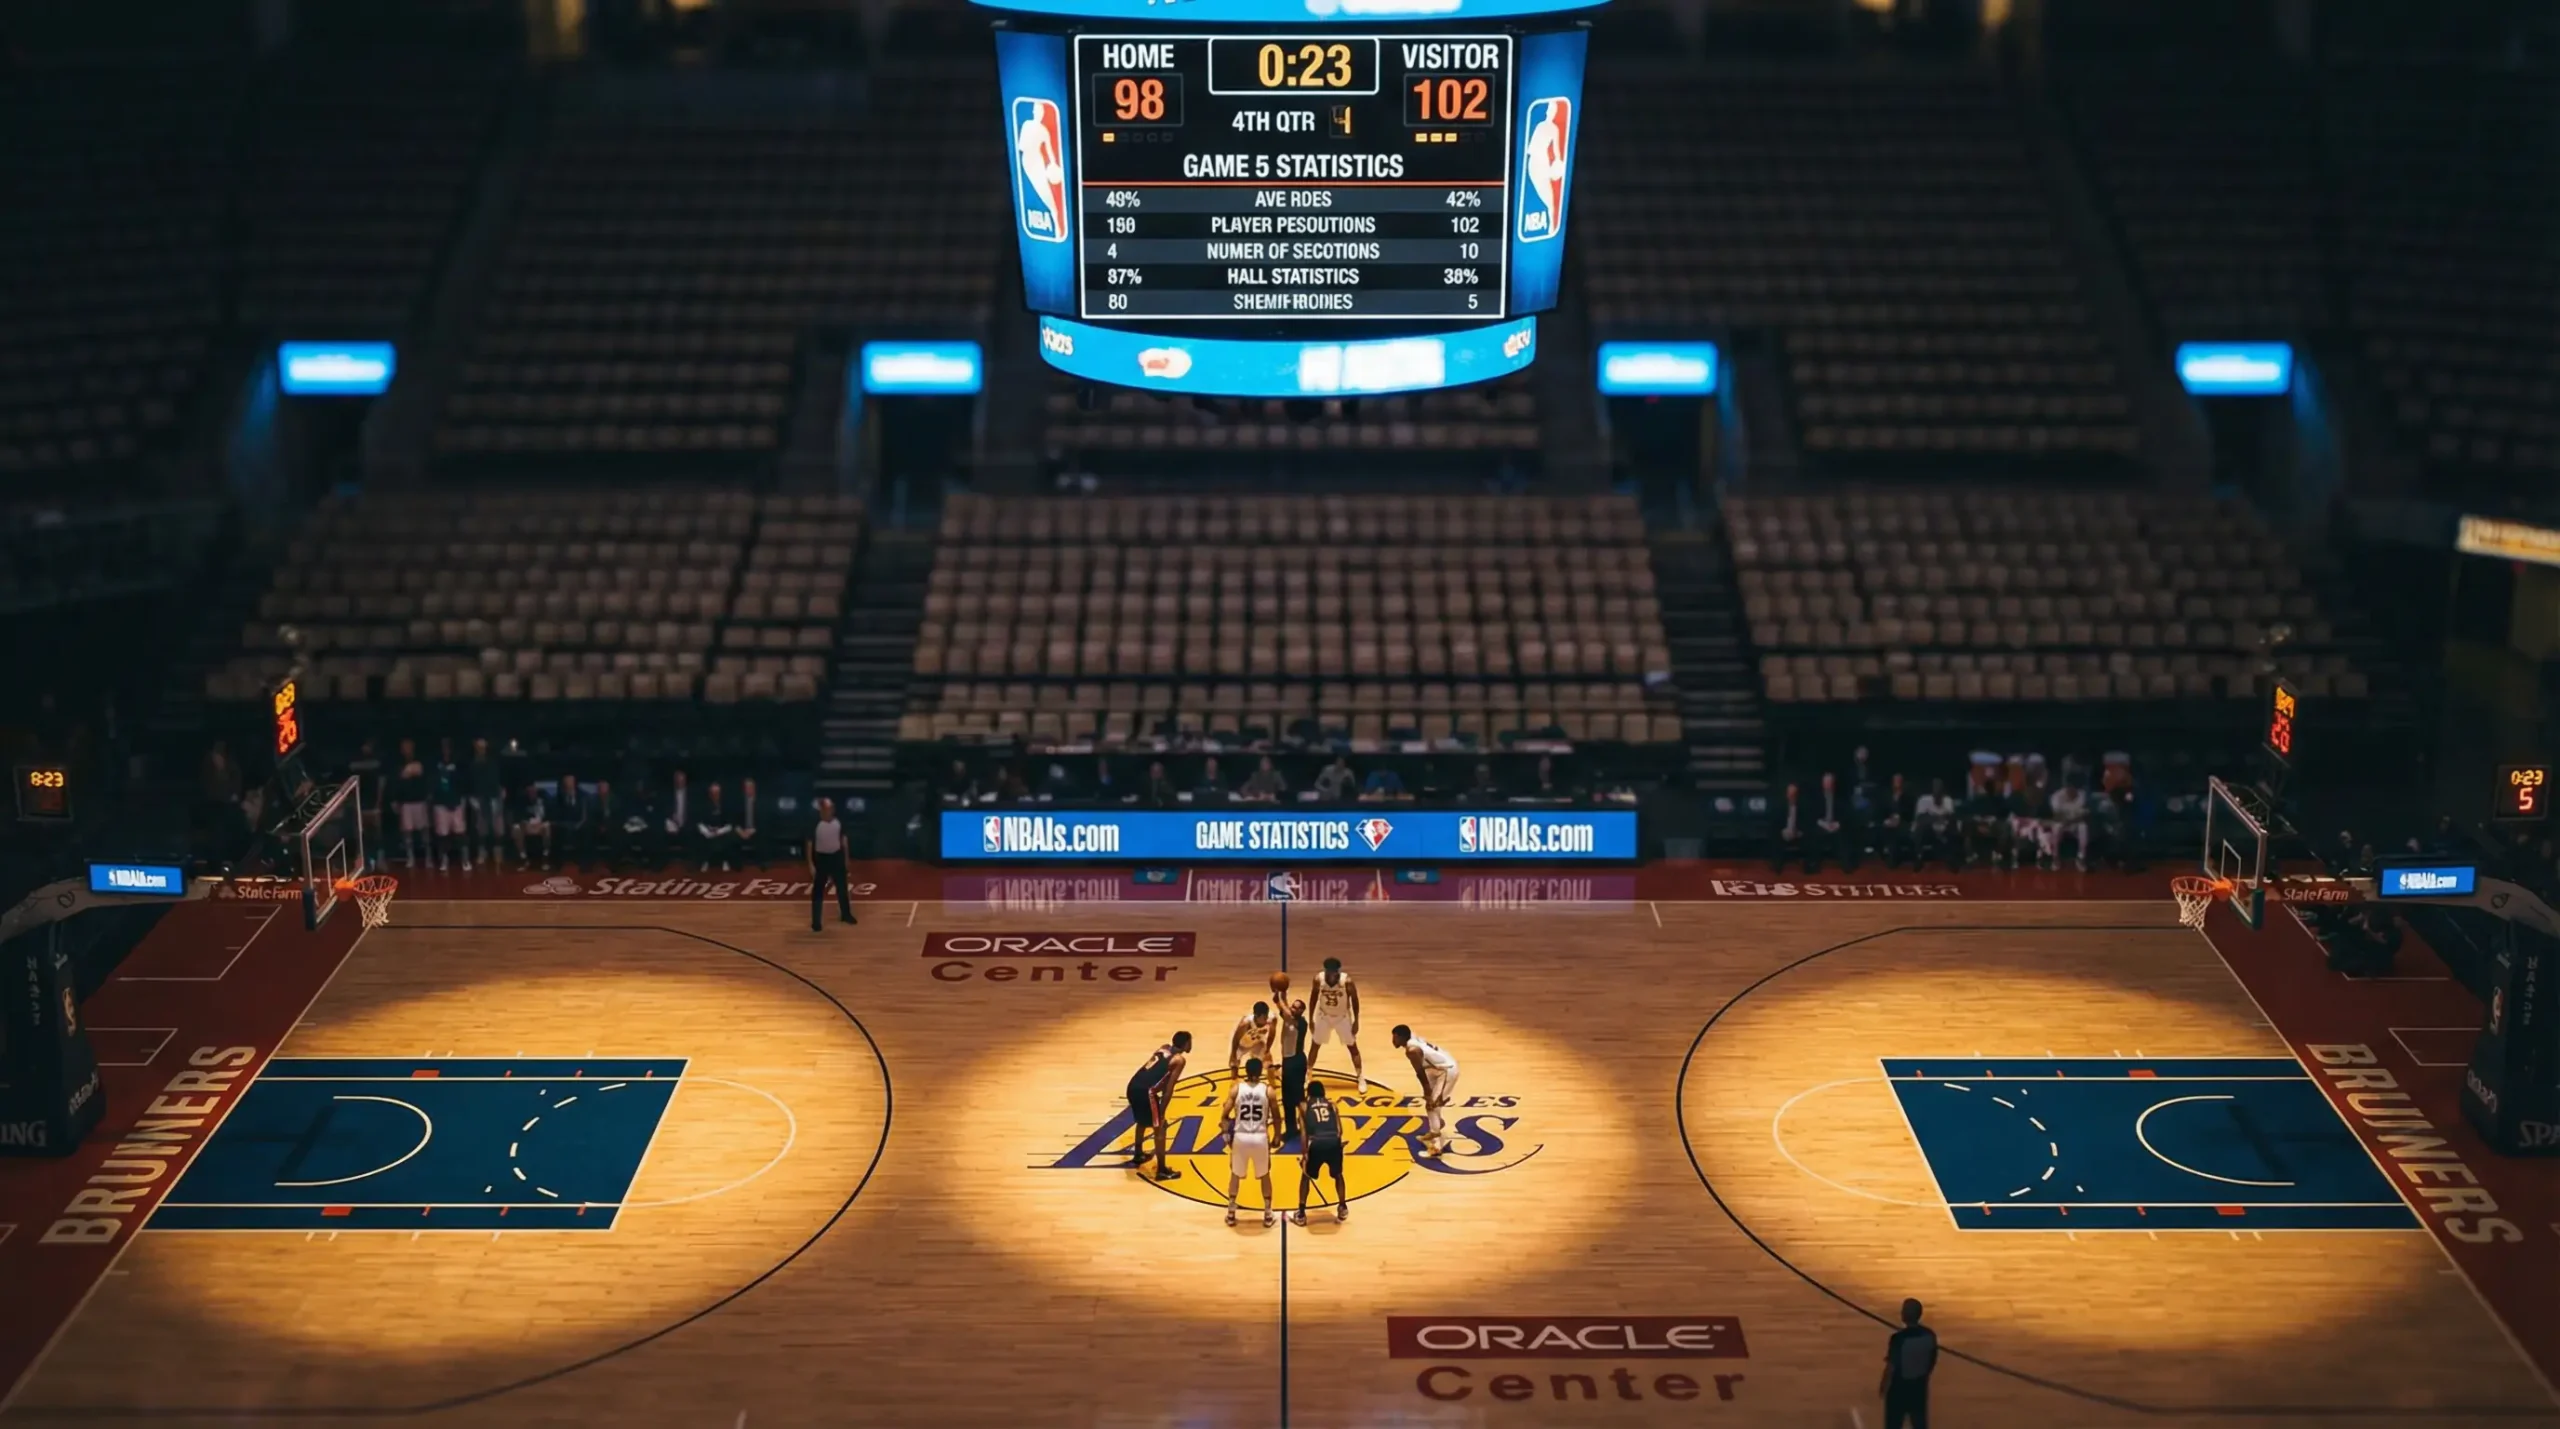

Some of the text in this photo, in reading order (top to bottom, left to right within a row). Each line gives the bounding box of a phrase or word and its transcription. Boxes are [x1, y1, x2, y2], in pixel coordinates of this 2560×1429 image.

[1103, 43, 1175, 69] HOME
[1258, 43, 1352, 87] 0:23
[1402, 43, 1499, 69] VISITOR
[1114, 79, 1165, 120] 98
[1413, 79, 1488, 120] 102
[1232, 111, 1315, 133] 4TH QTR
[1183, 154, 1404, 178] GAME 5 STATISTICS
[1255, 190, 1332, 208] AVE RDES
[1446, 190, 1481, 208] 42%
[1211, 216, 1376, 234] PLAYER PESOUTIONS
[1451, 216, 1480, 234] 102
[1107, 242, 1118, 260] 4
[1207, 242, 1380, 260] NUMER OF SECOTIONS
[1460, 242, 1479, 260] 10
[1107, 268, 1142, 285] 87%
[1227, 268, 1360, 285] HALL STATISTICS
[1108, 293, 1128, 310] 80
[1468, 293, 1479, 310] 5
[2519, 787, 2533, 810] 5
[1196, 821, 1349, 850] GAME STATISTICS
[944, 936, 1174, 953] ORACLE
[931, 961, 1178, 982] Center
[1240, 1104, 1263, 1121] 25
[1416, 1325, 1715, 1350] ORACLE
[1416, 1365, 1744, 1402] Center
